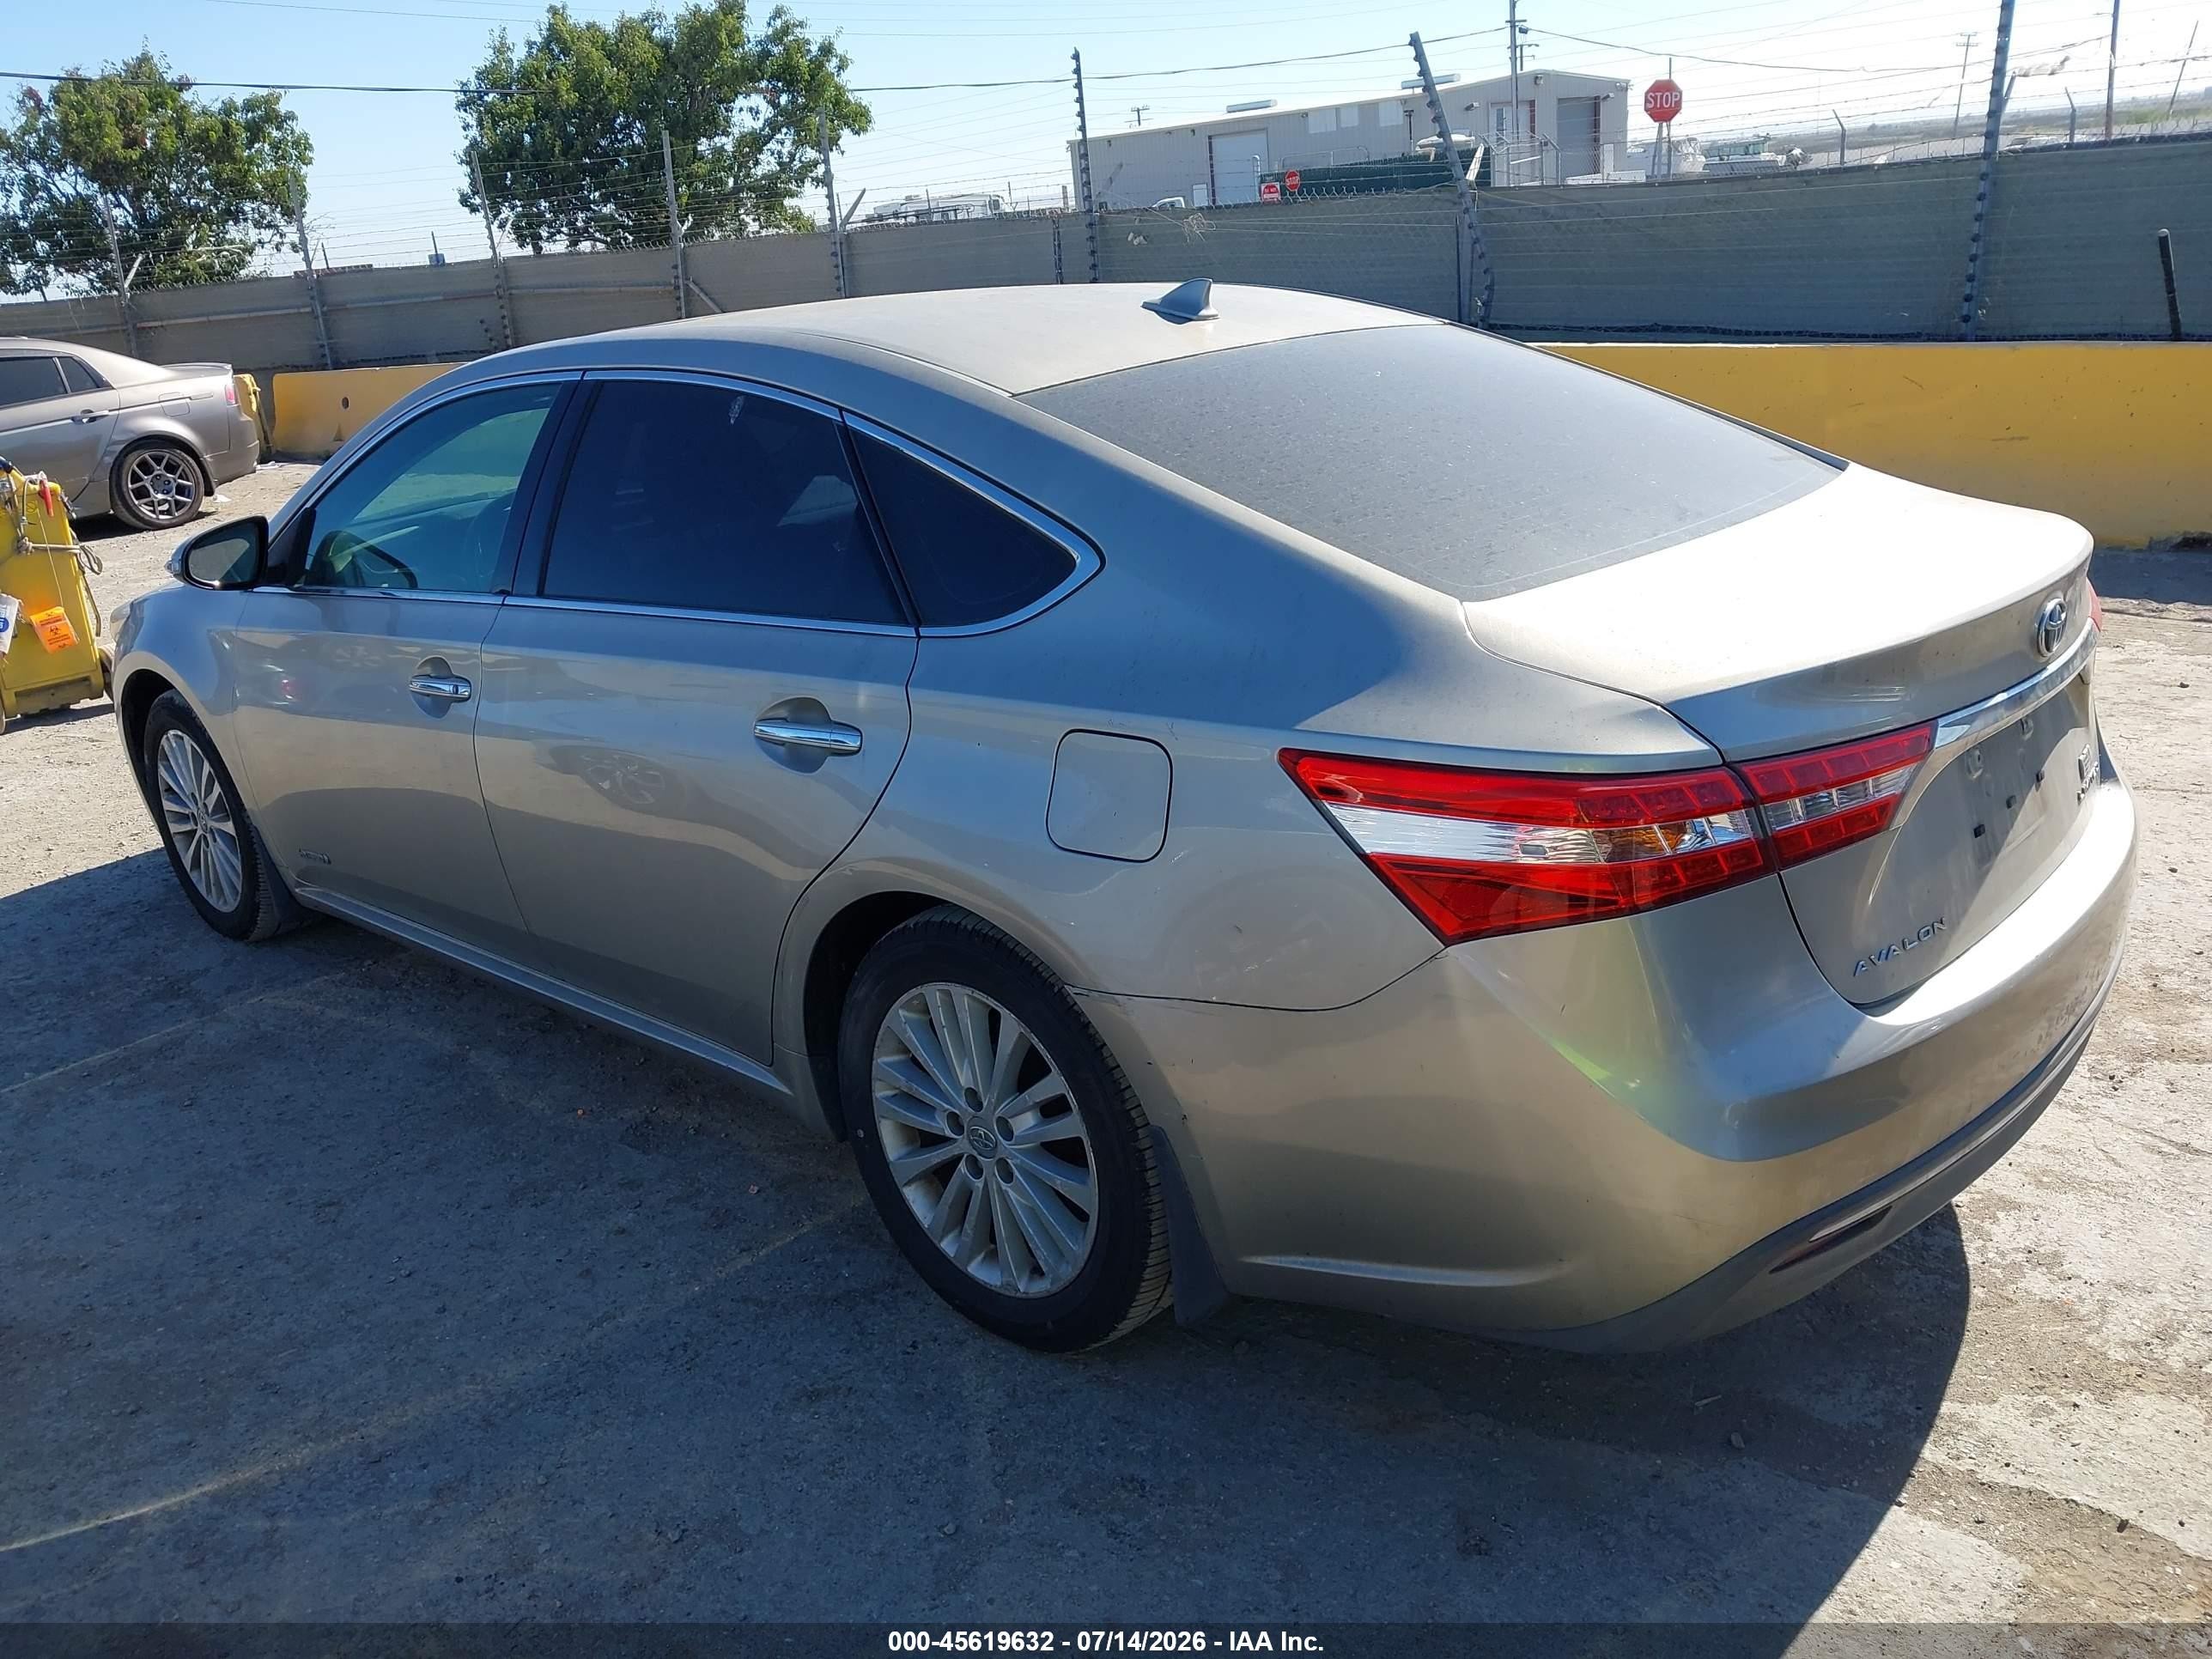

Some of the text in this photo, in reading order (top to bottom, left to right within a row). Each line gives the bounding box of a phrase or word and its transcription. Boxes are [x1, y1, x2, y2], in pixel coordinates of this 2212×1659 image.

[1648, 92, 1680, 108] STOP
[1286, 176, 1299, 185] STOP
[1853, 916, 1948, 977] AVALON
